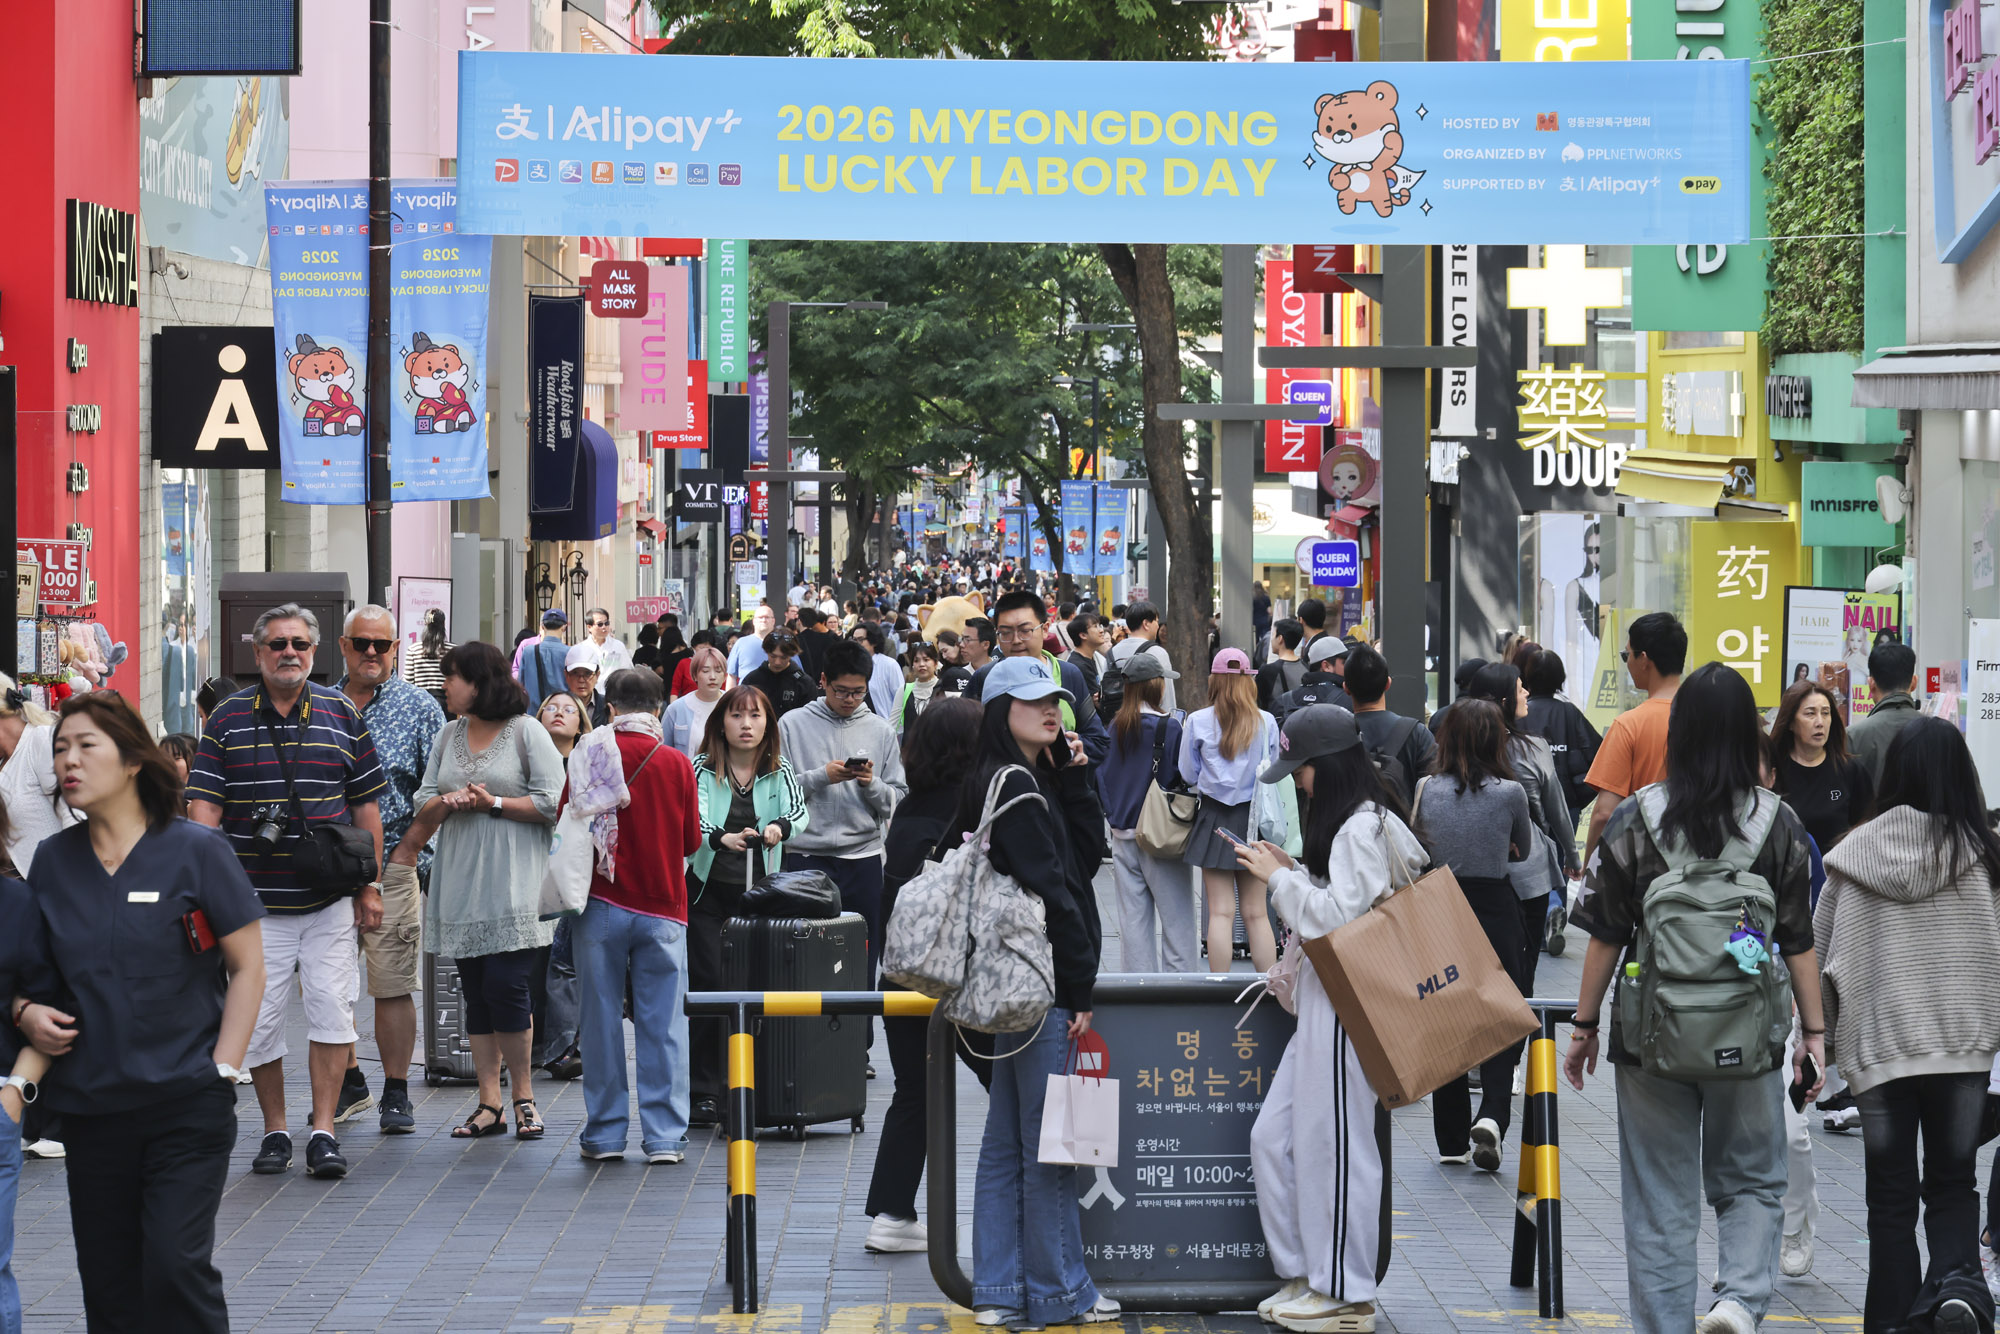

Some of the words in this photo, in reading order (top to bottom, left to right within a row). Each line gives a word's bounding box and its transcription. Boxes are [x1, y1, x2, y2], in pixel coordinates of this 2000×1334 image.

[496, 103, 539, 140] 支
[777, 105, 895, 143] 2026
[909, 108, 1278, 146] MYEONGDONG
[1443, 118, 1499, 129] HOSTED
[1502, 118, 1520, 129] BY
[1443, 148, 1525, 160] ORGANIZED
[1528, 148, 1547, 160] BY
[1587, 148, 1682, 161] PPLNETWORKS
[720, 171, 739, 184] Pay
[778, 154, 956, 194] LUCKY
[970, 156, 1147, 196] LABOR
[1163, 158, 1278, 197] DAY
[1443, 178, 1525, 190] SUPPORTED
[1528, 179, 1546, 190] BY
[1695, 178, 1716, 191] pay
[75, 198, 139, 308] MISSHA
[609, 270, 630, 280] ALL
[603, 283, 636, 295] MASK
[601, 298, 637, 310] STORY
[720, 283, 735, 374] REPUBLIC
[641, 292, 666, 404] ETUDE
[1451, 296, 1468, 407] LOVRS
[559, 359, 574, 418] Rockfish
[1293, 392, 1325, 402] QUEEN
[546, 365, 560, 452] Weatherwear
[1520, 365, 1607, 451] 藥
[657, 434, 677, 443] Drug
[679, 434, 703, 442] Store
[1533, 442, 1630, 487] DOUB
[685, 483, 718, 500] VT
[1316, 553, 1350, 564] QUEEN
[1313, 566, 1357, 577] HOLIDAY
[1717, 545, 1770, 600] 药
[1800, 616, 1830, 628] HAIR
[1843, 604, 1898, 633] NAIL
[1716, 626, 1770, 683] 약
[1416, 964, 1460, 1000] MLB
[1135, 1102, 1163, 1114] 걸으면
[1207, 1101, 1233, 1114] 서울이
[1135, 1138, 1180, 1152] 운영시간
[1136, 1164, 1175, 1188] 매일
[1102, 1244, 1155, 1260] 중구청장
[1186, 1242, 1267, 1259] 서울남대문경
